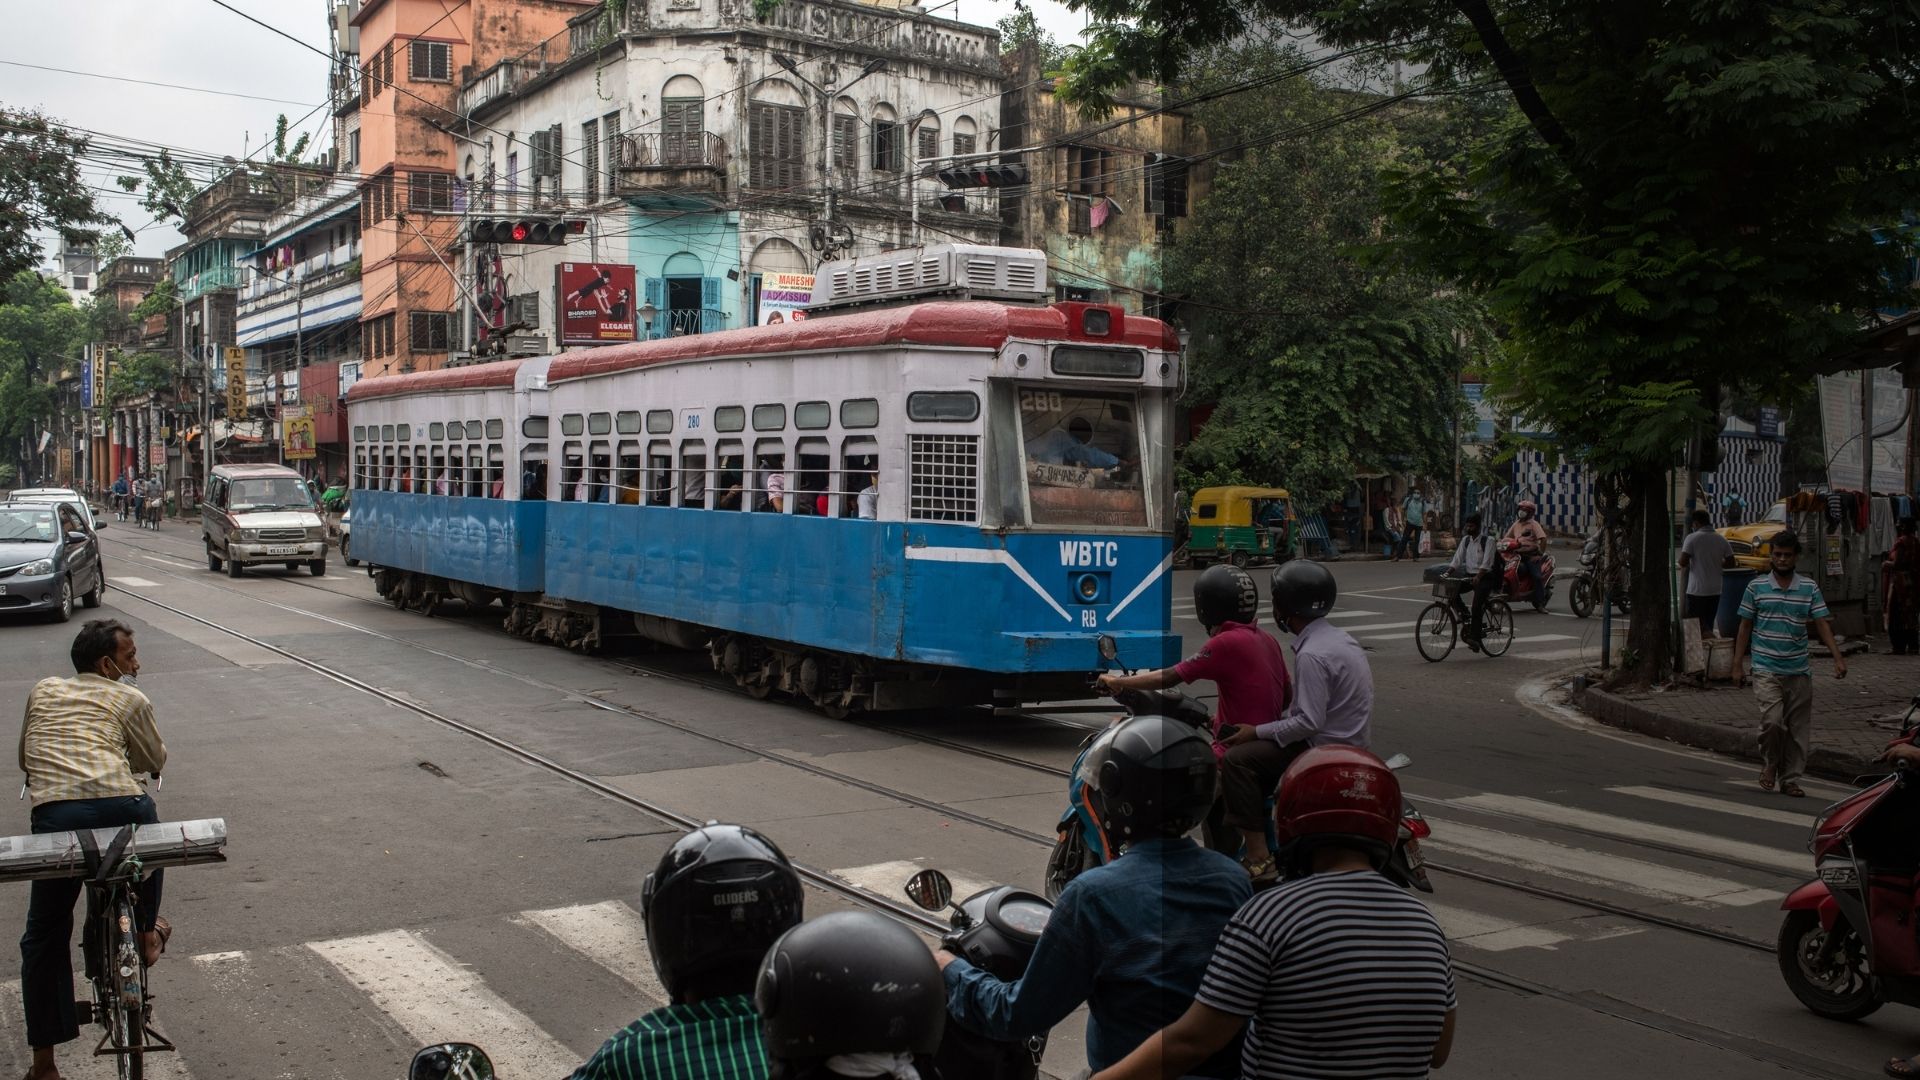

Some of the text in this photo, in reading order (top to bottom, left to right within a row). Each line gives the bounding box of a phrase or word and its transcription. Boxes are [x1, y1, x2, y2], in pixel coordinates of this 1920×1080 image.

[1020, 391, 1062, 412] 280
[687, 414, 700, 429] 280
[1036, 465, 1046, 479] 5
[1059, 540, 1118, 567] WBTC
[1081, 609, 1097, 628] RB
[713, 890, 759, 906] GLIDERS
